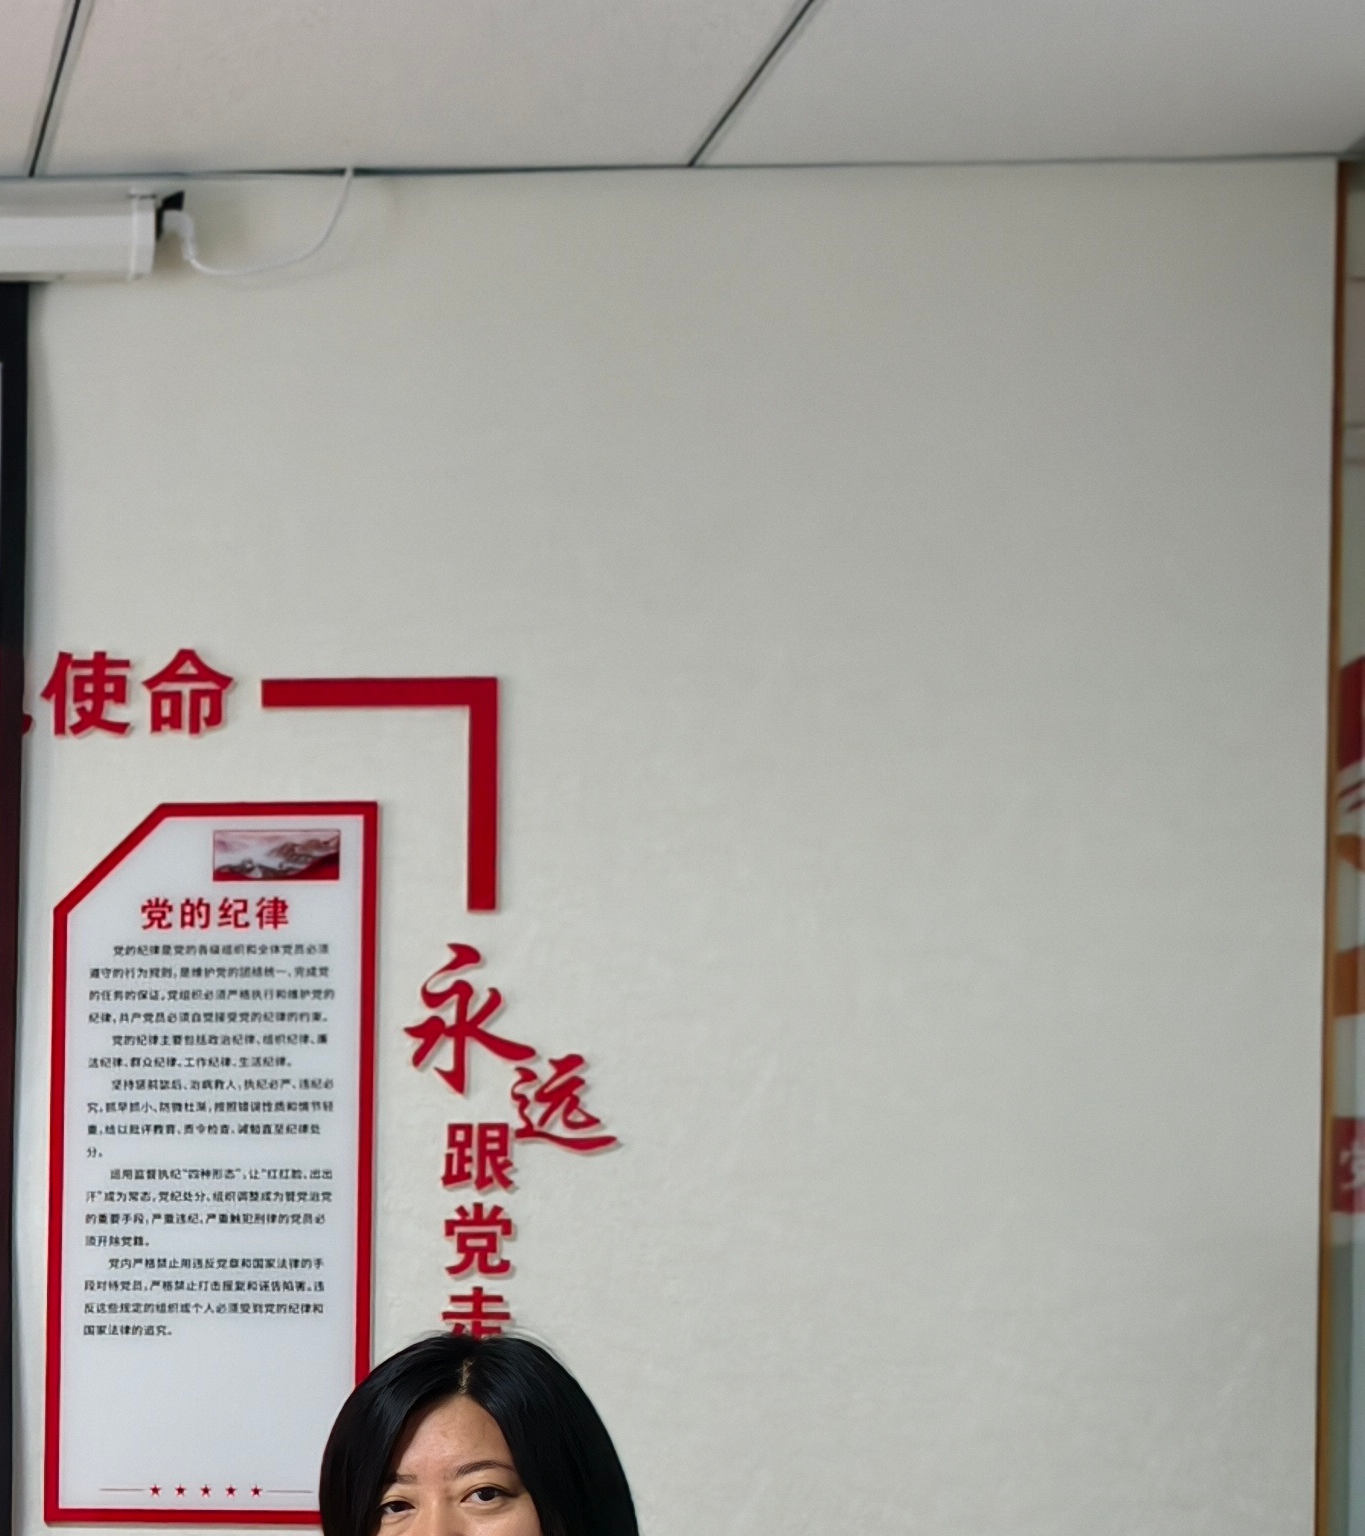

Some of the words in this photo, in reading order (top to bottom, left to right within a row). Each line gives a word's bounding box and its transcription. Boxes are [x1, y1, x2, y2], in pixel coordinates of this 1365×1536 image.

[22, 649, 233, 737] 使命
[140, 896, 290, 930] 党的纪律
[403, 943, 618, 1152] 永远
[441, 1122, 515, 1340] 跟党走
